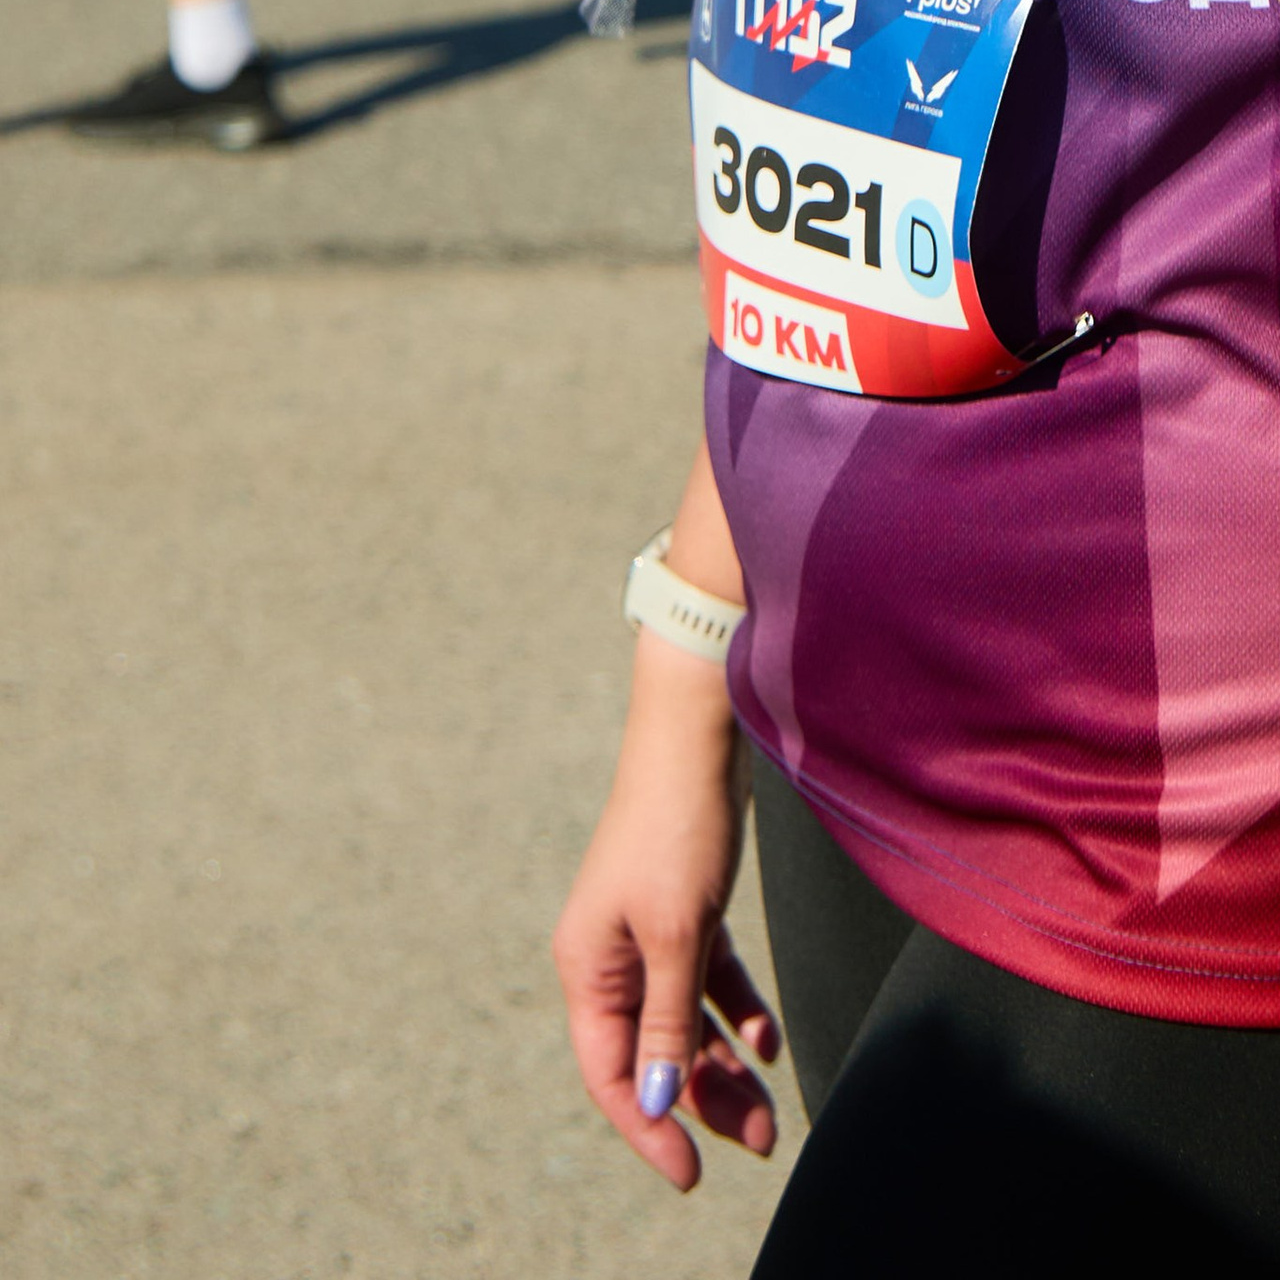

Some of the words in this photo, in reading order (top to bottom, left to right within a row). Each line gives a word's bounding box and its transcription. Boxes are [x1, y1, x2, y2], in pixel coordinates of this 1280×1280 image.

[713, 125, 884, 269] 3021
[910, 215, 938, 278] D
[731, 297, 764, 347] 10
